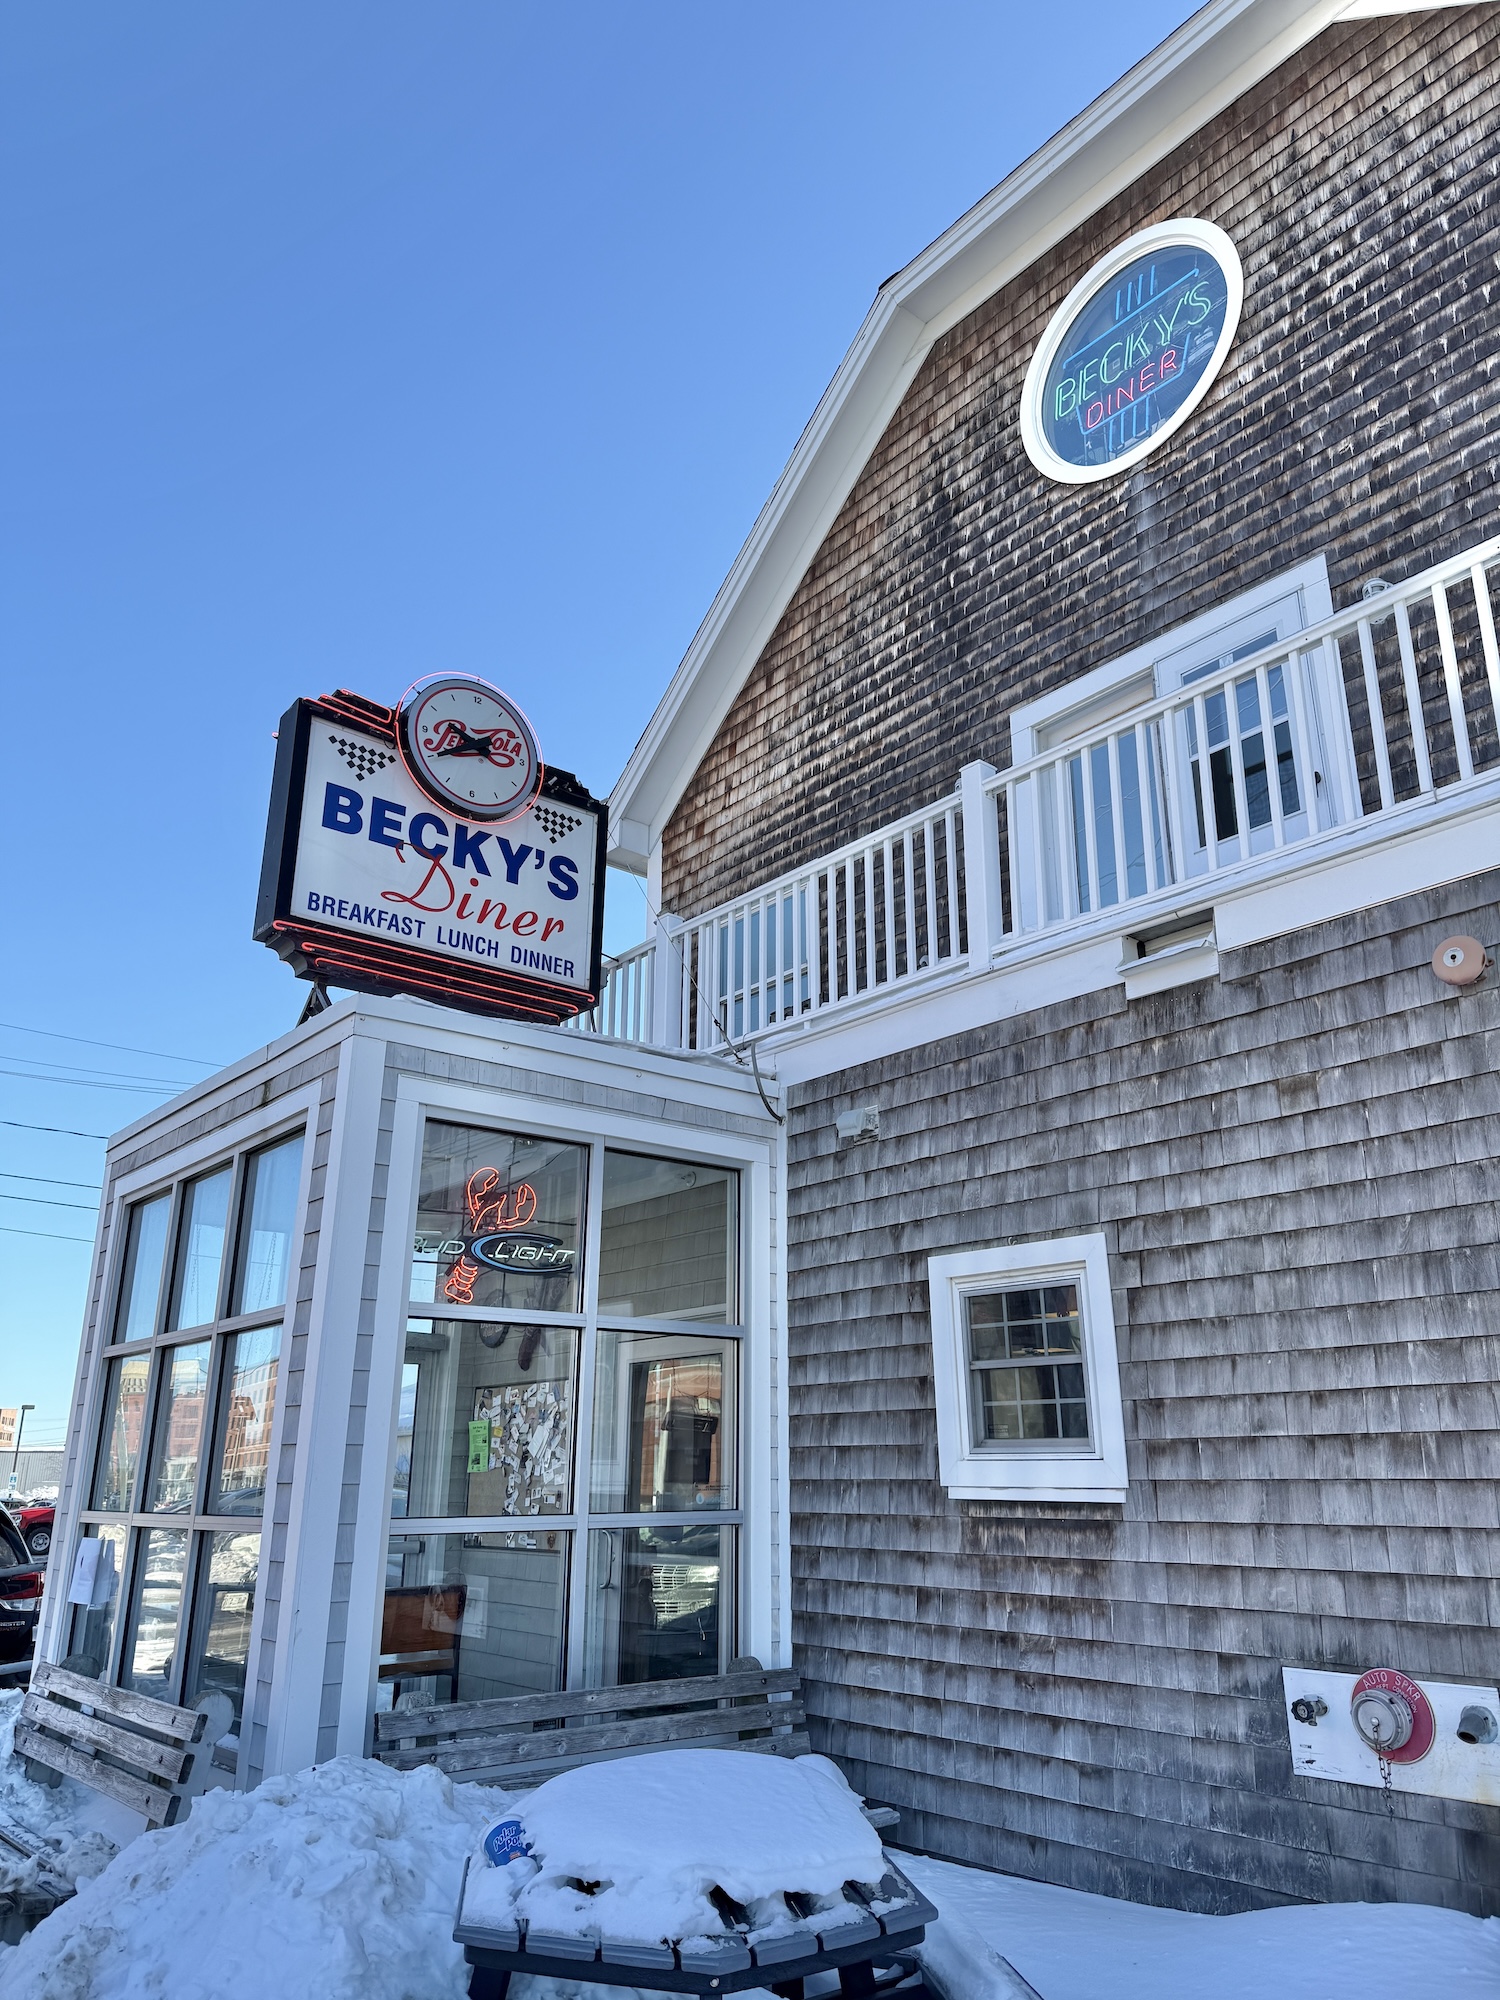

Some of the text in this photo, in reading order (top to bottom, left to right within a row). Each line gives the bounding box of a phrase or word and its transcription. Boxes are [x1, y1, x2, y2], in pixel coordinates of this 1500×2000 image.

[1054, 281, 1212, 421] BECKY'S
[1086, 350, 1176, 429] DINER
[422, 725, 428, 733] 9
[474, 696, 482, 704] 12
[321, 781, 579, 901] BECKY'S
[380, 843, 564, 942] Diner
[307, 891, 575, 978] BREAKFAST LUNCH DINNER
[488, 1242, 575, 1263] LIGHT
[1362, 1671, 1421, 1701] AUTO SPKR
